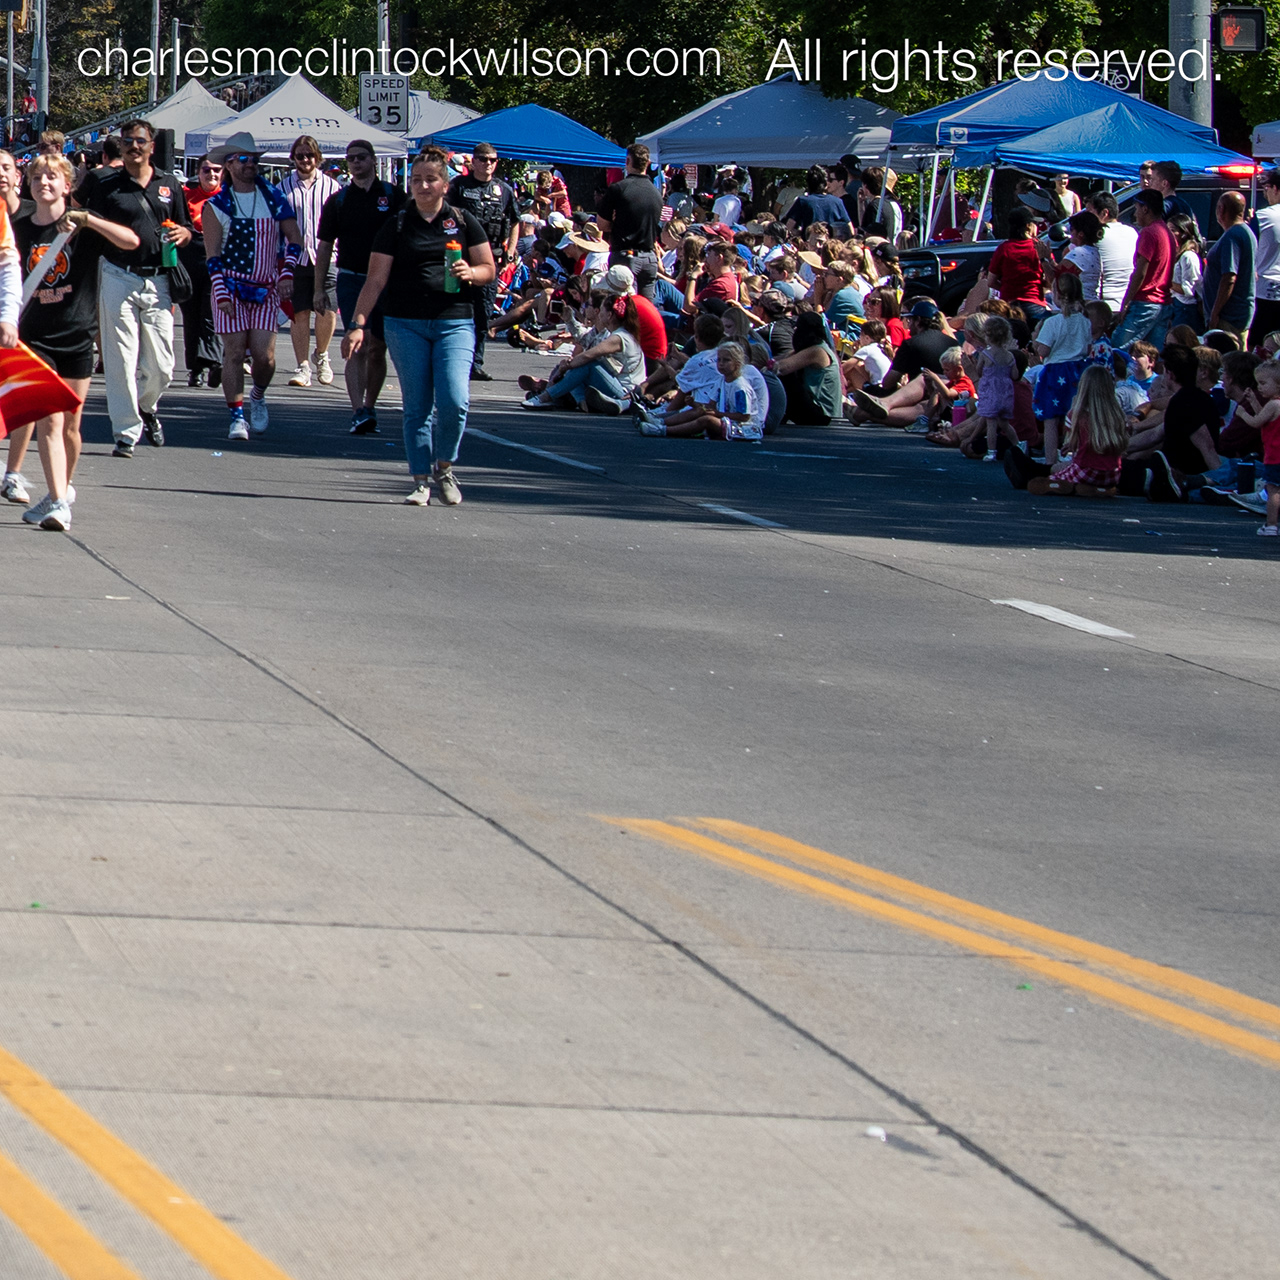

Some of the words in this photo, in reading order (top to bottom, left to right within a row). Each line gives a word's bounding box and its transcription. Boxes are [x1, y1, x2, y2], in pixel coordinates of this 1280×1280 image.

[364, 78, 404, 89] SPEED
[368, 92, 400, 102] LIMIT
[367, 105, 402, 125] 35
[269, 116, 341, 129] mpm
